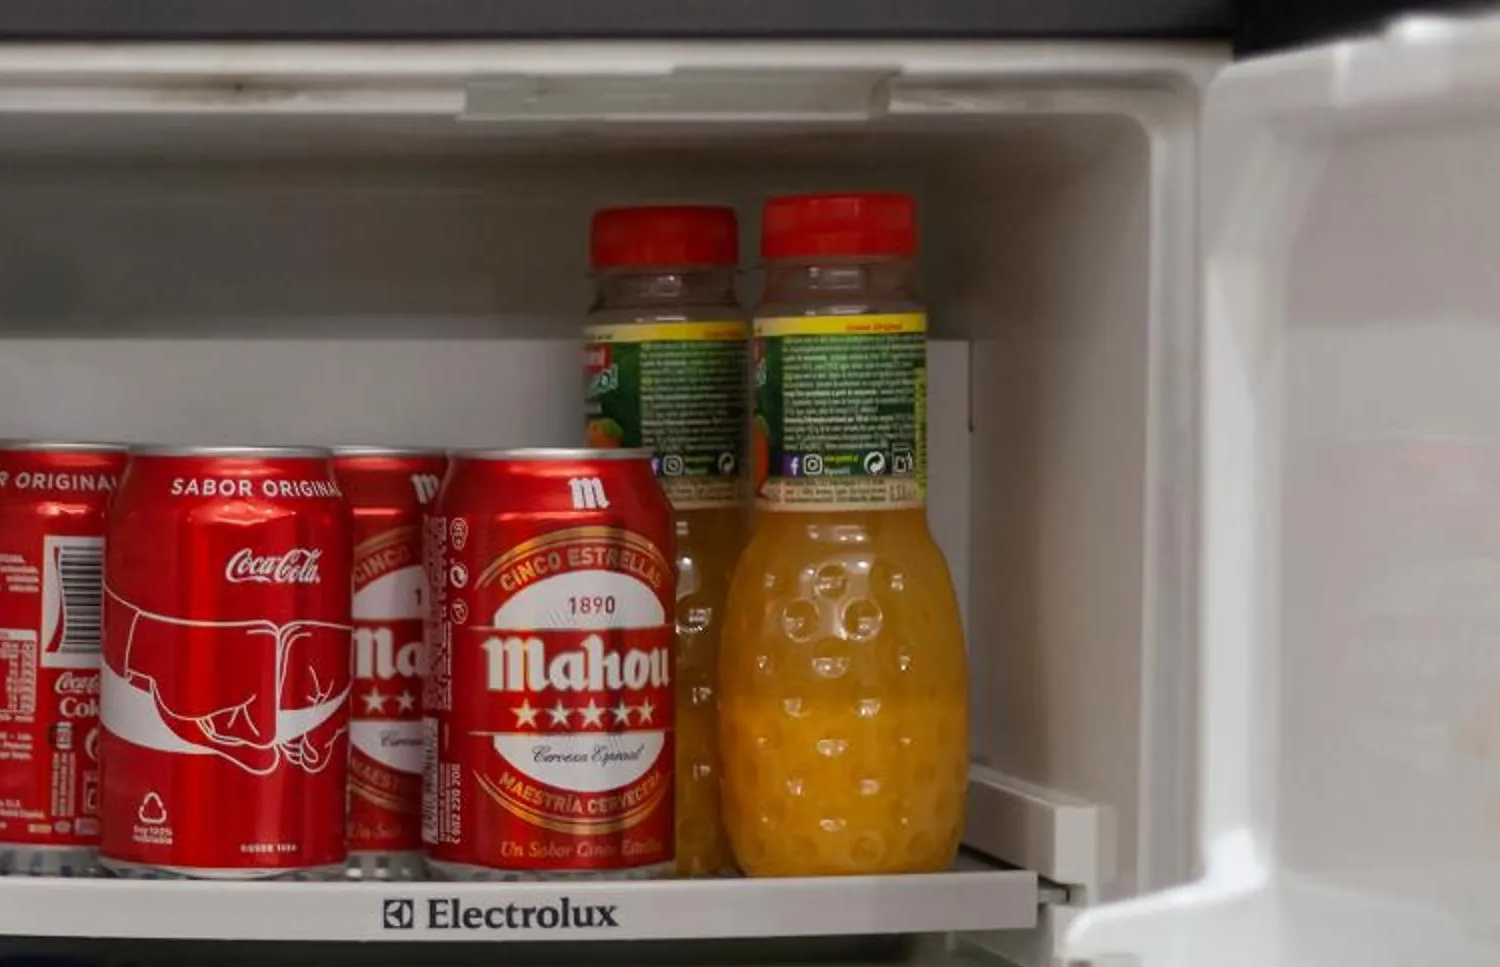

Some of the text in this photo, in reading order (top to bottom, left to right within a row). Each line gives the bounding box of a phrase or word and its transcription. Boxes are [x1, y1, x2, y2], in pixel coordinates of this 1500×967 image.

[171, 477, 252, 496] SABOR
[500, 546, 662, 592] CINCO ESTRELLAS
[568, 595, 616, 615] 1890
[480, 633, 671, 692] Mahou
[499, 771, 583, 813] MAESTRÍA
[428, 897, 619, 929] Electrolux
